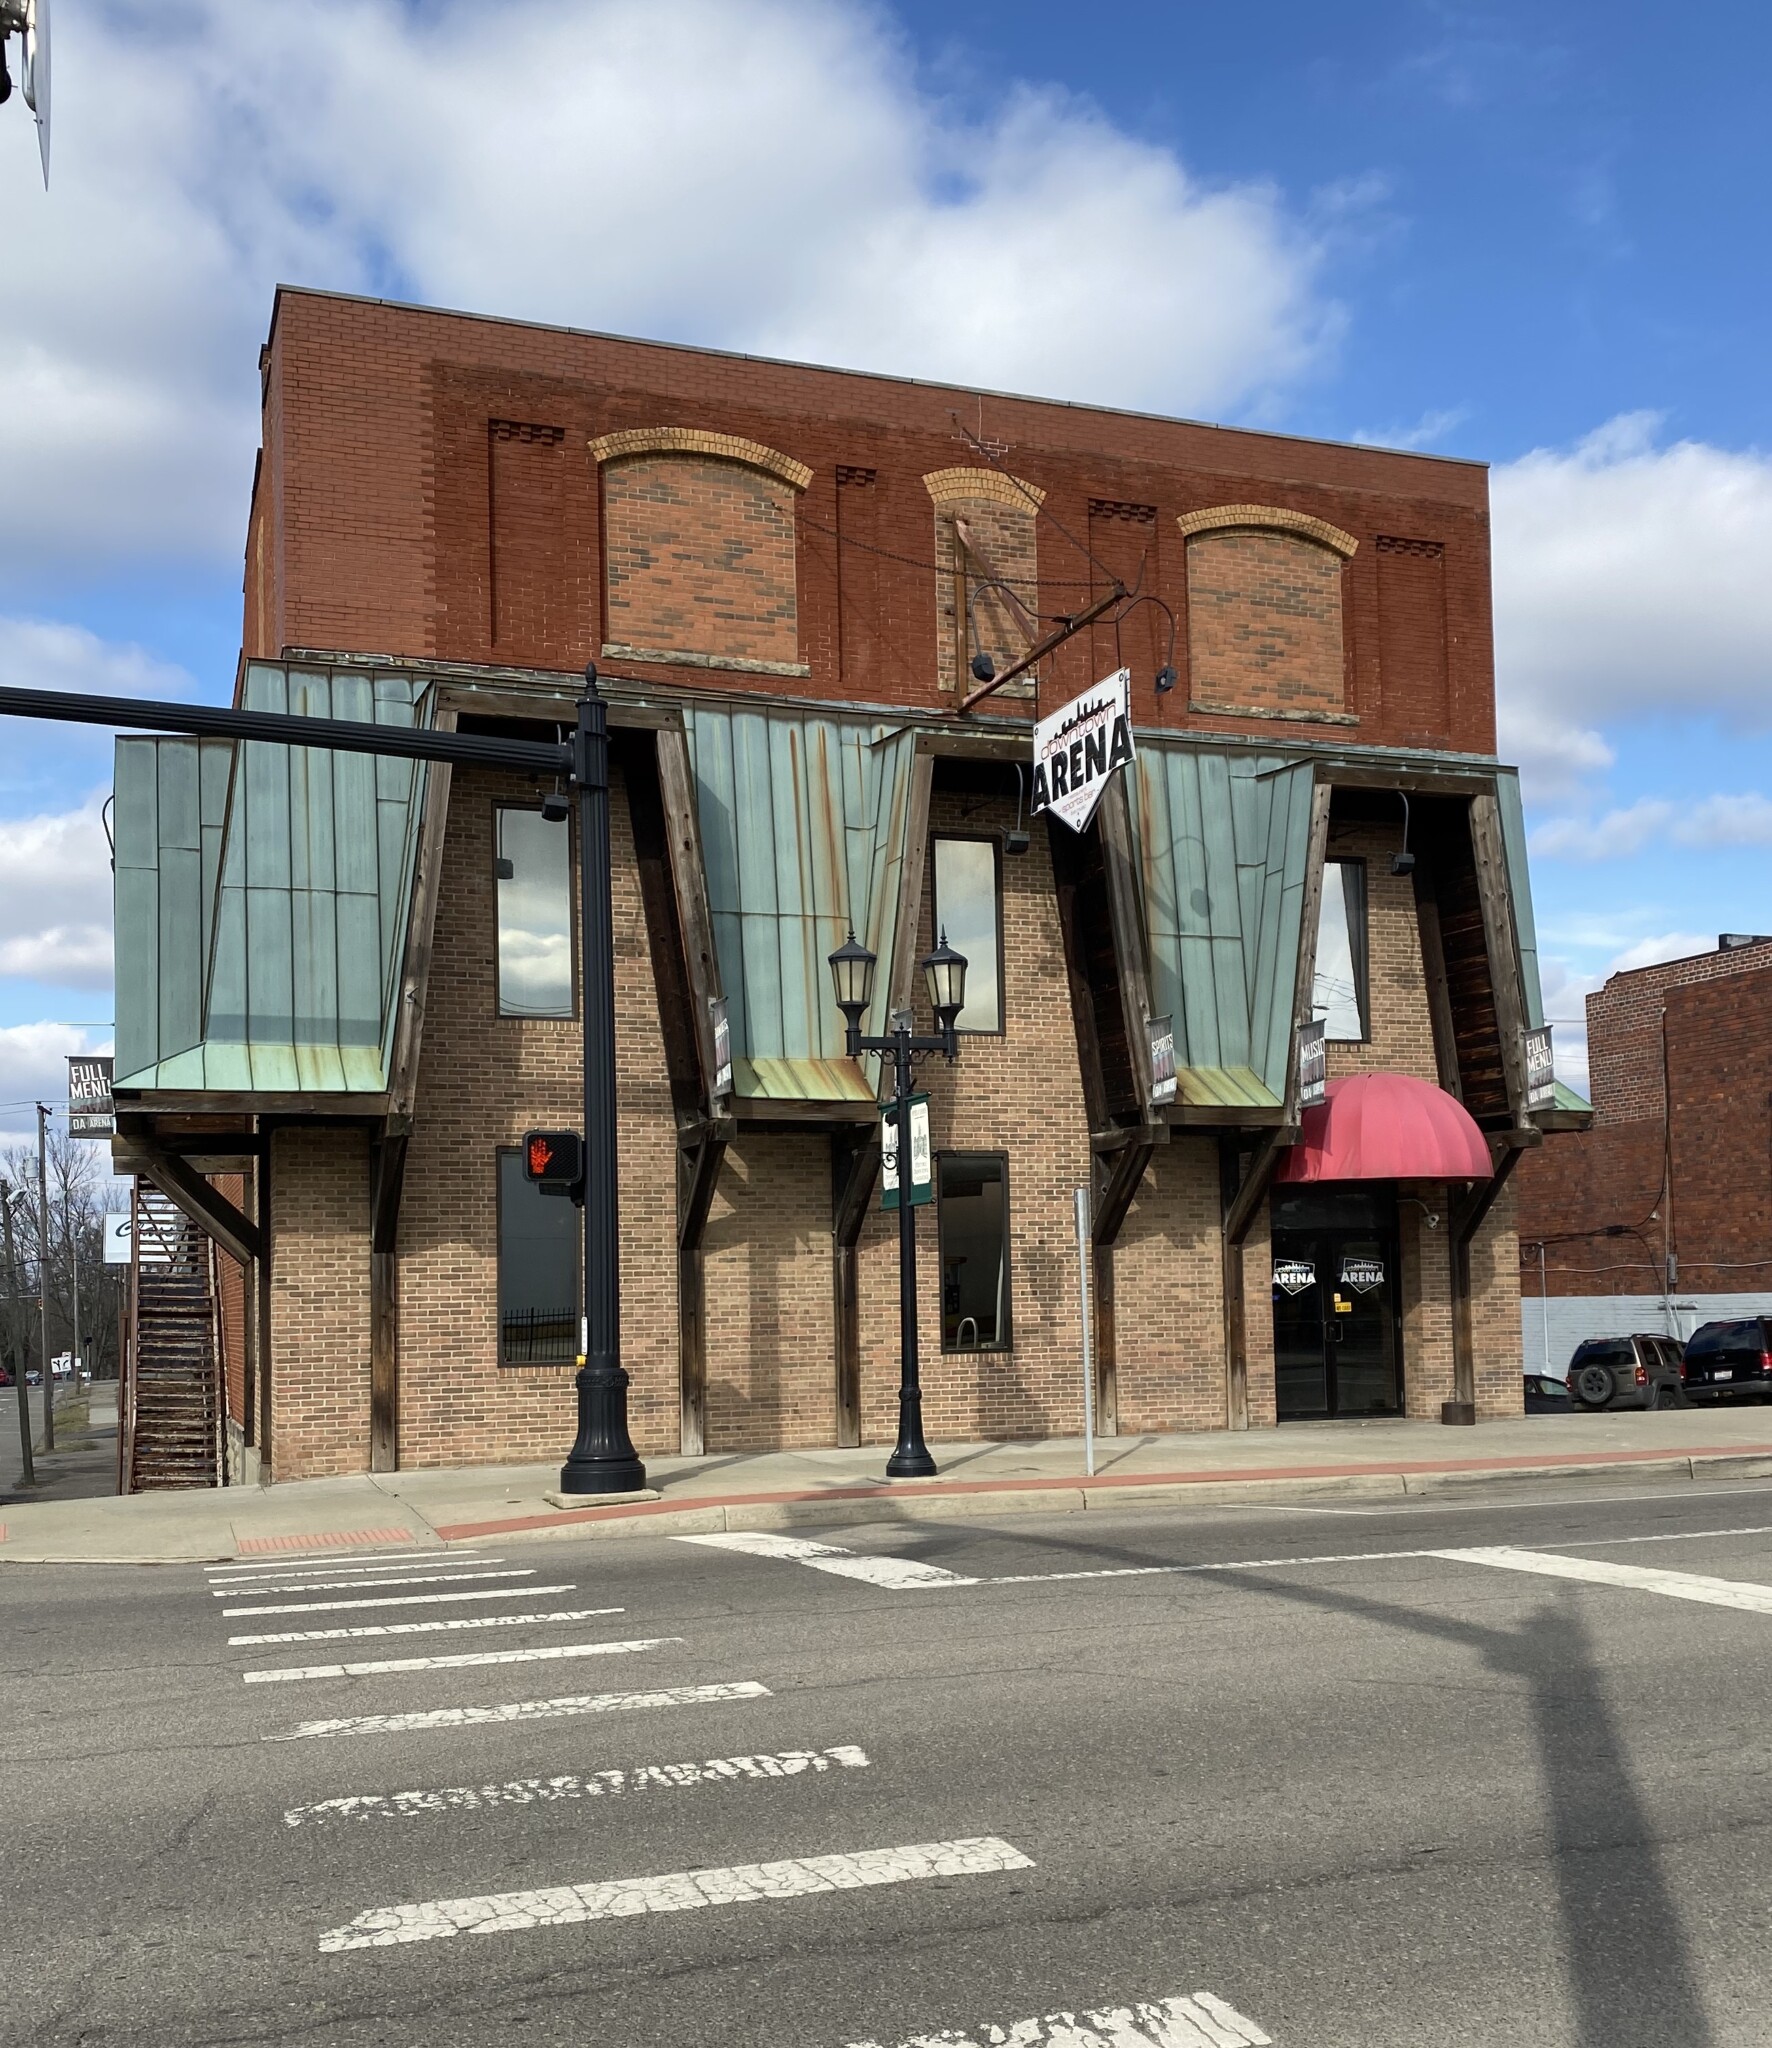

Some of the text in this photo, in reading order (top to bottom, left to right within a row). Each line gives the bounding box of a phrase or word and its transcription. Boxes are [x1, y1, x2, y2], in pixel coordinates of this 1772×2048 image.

[1041, 703, 1116, 760] downtown
[1032, 714, 1134, 813] ARENA
[1152, 1033, 1173, 1057] SPIRITS
[1301, 1037, 1325, 1063] MUSIC
[1526, 1034, 1548, 1057] FULL
[1527, 1049, 1552, 1073] MENU
[71, 1064, 107, 1083] FULL
[70, 1079, 111, 1099] MENU
[89, 1117, 111, 1128] ARENA
[1272, 1272, 1316, 1284] ARENA
[1340, 1272, 1384, 1282] ARENA
